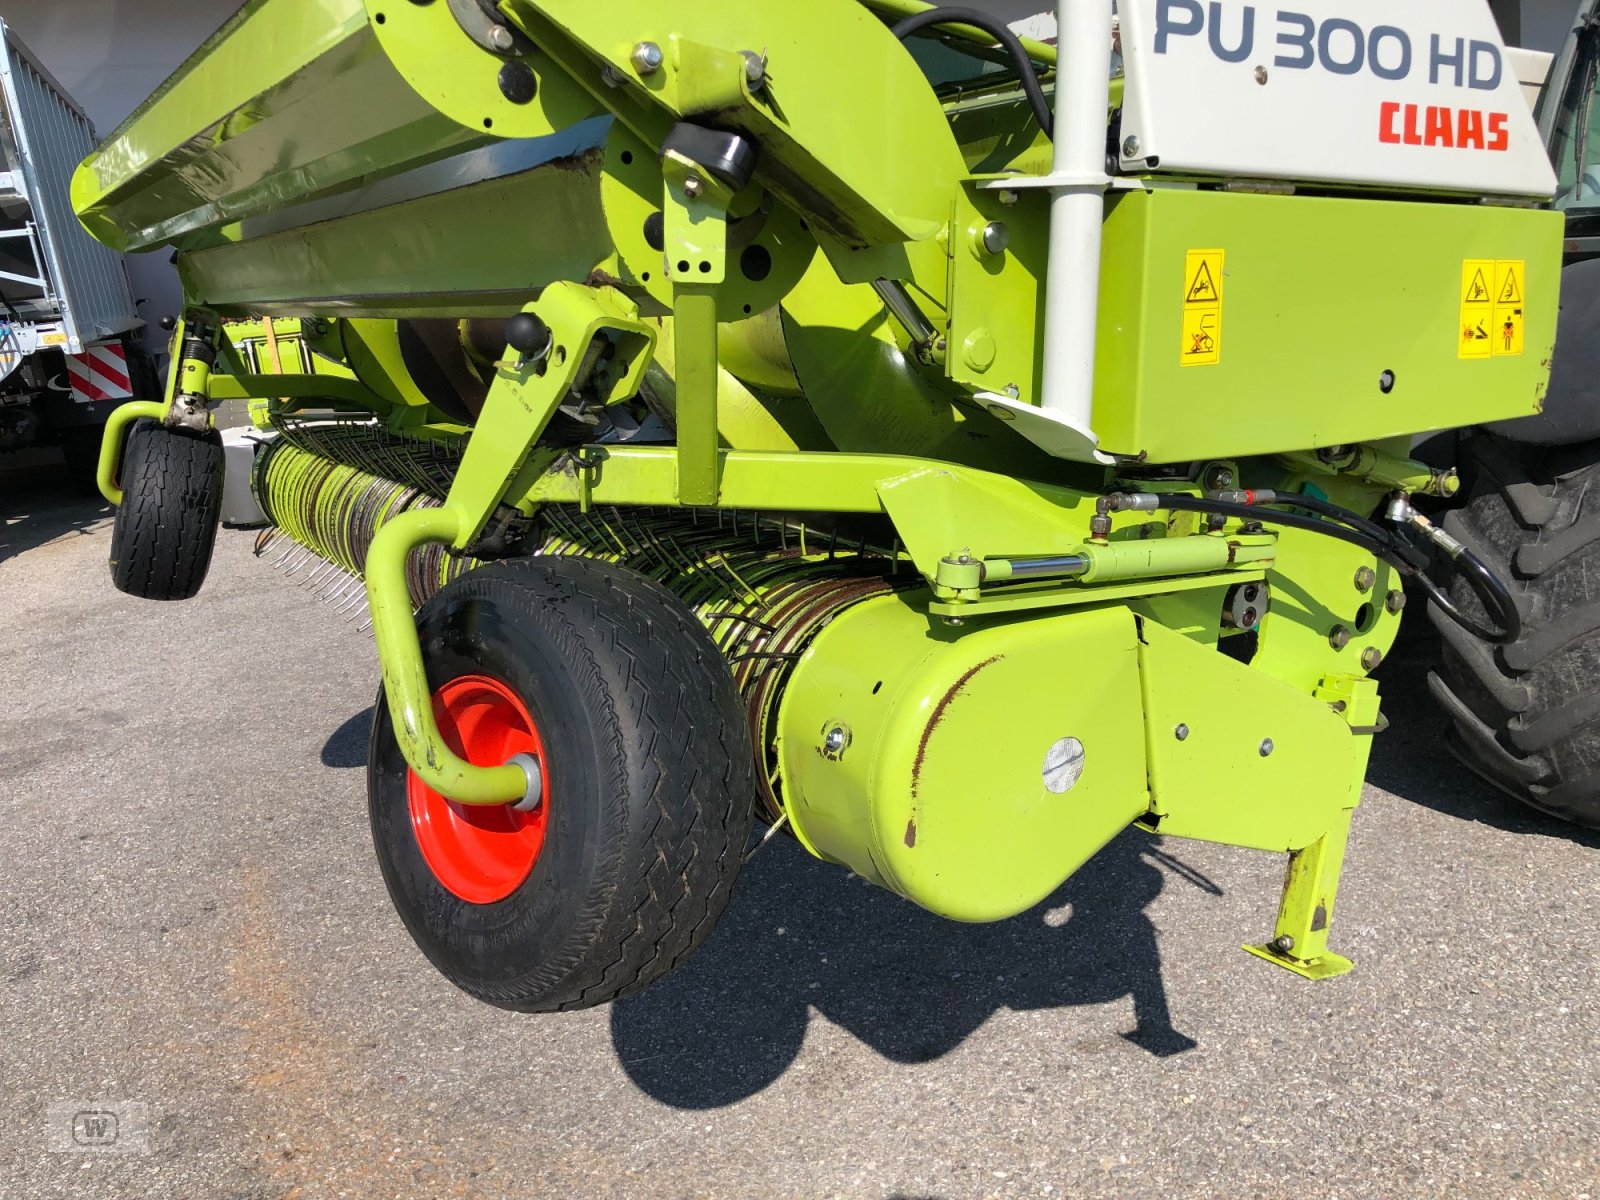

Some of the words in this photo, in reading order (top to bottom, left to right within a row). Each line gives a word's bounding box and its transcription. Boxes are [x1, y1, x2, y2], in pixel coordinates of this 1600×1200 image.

[1154, 0, 1255, 63] PU
[1274, 10, 1412, 80] 300
[1429, 33, 1503, 91] HD
[1378, 101, 1509, 151] CLAAS
